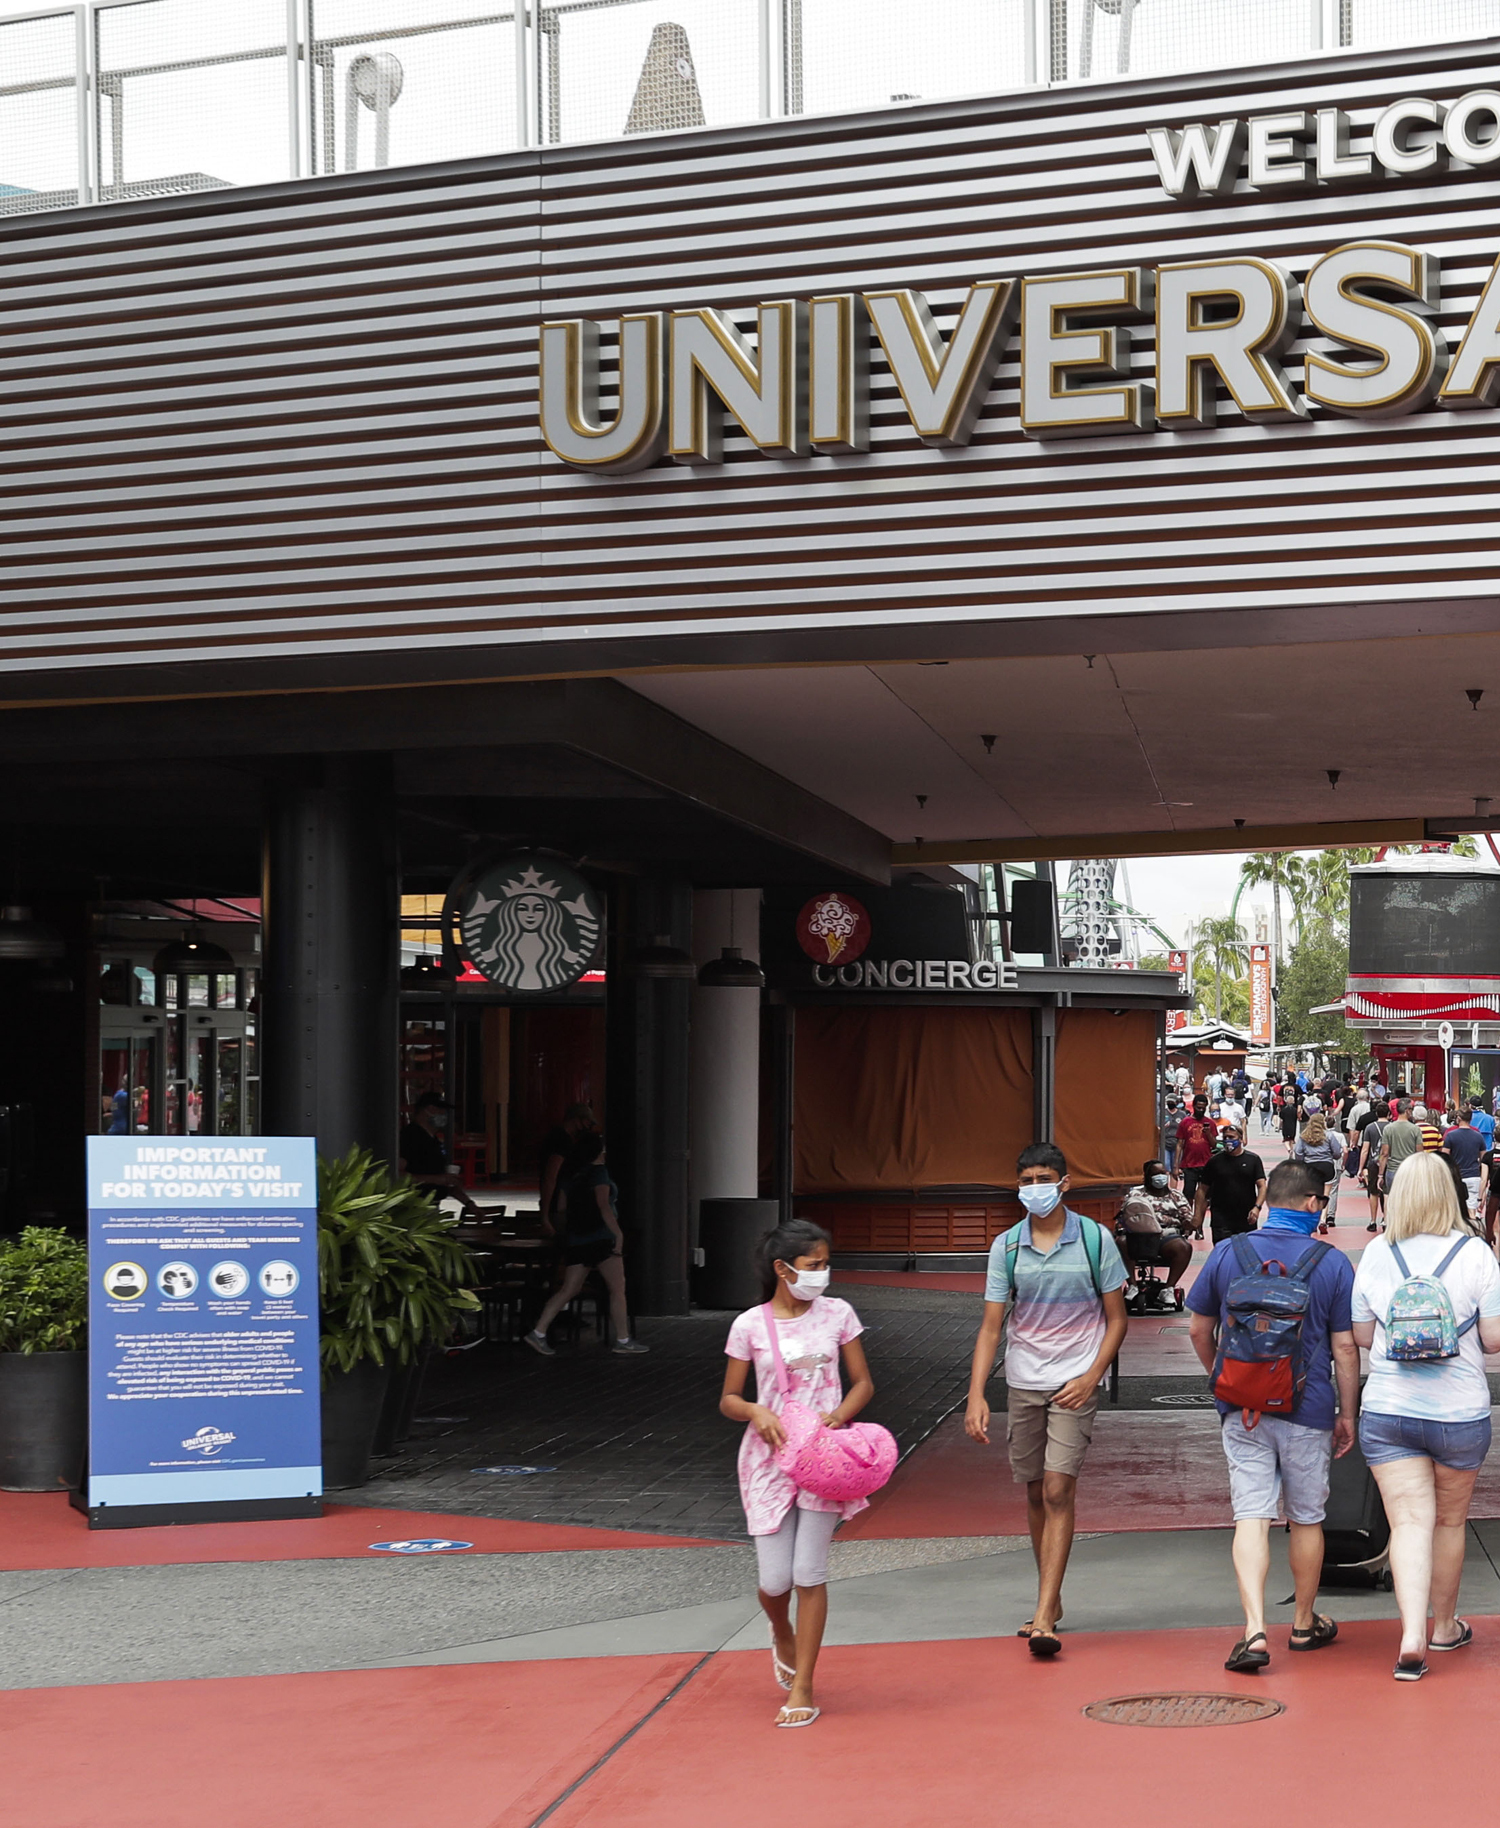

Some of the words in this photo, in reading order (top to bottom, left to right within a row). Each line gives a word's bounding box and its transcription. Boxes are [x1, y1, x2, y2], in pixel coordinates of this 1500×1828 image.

[812, 960, 1018, 989] CONCIERGE
[1253, 964, 1262, 1036] SANDWICHES
[1166, 1010, 1176, 1033] ERY
[136, 1147, 268, 1163] IMPORTANT
[123, 1164, 282, 1181] INFORMATION
[101, 1183, 147, 1198] FOR
[150, 1182, 244, 1198] TODAY'S
[248, 1182, 303, 1198] VISIT
[181, 1431, 236, 1448] UNIVERSAL
